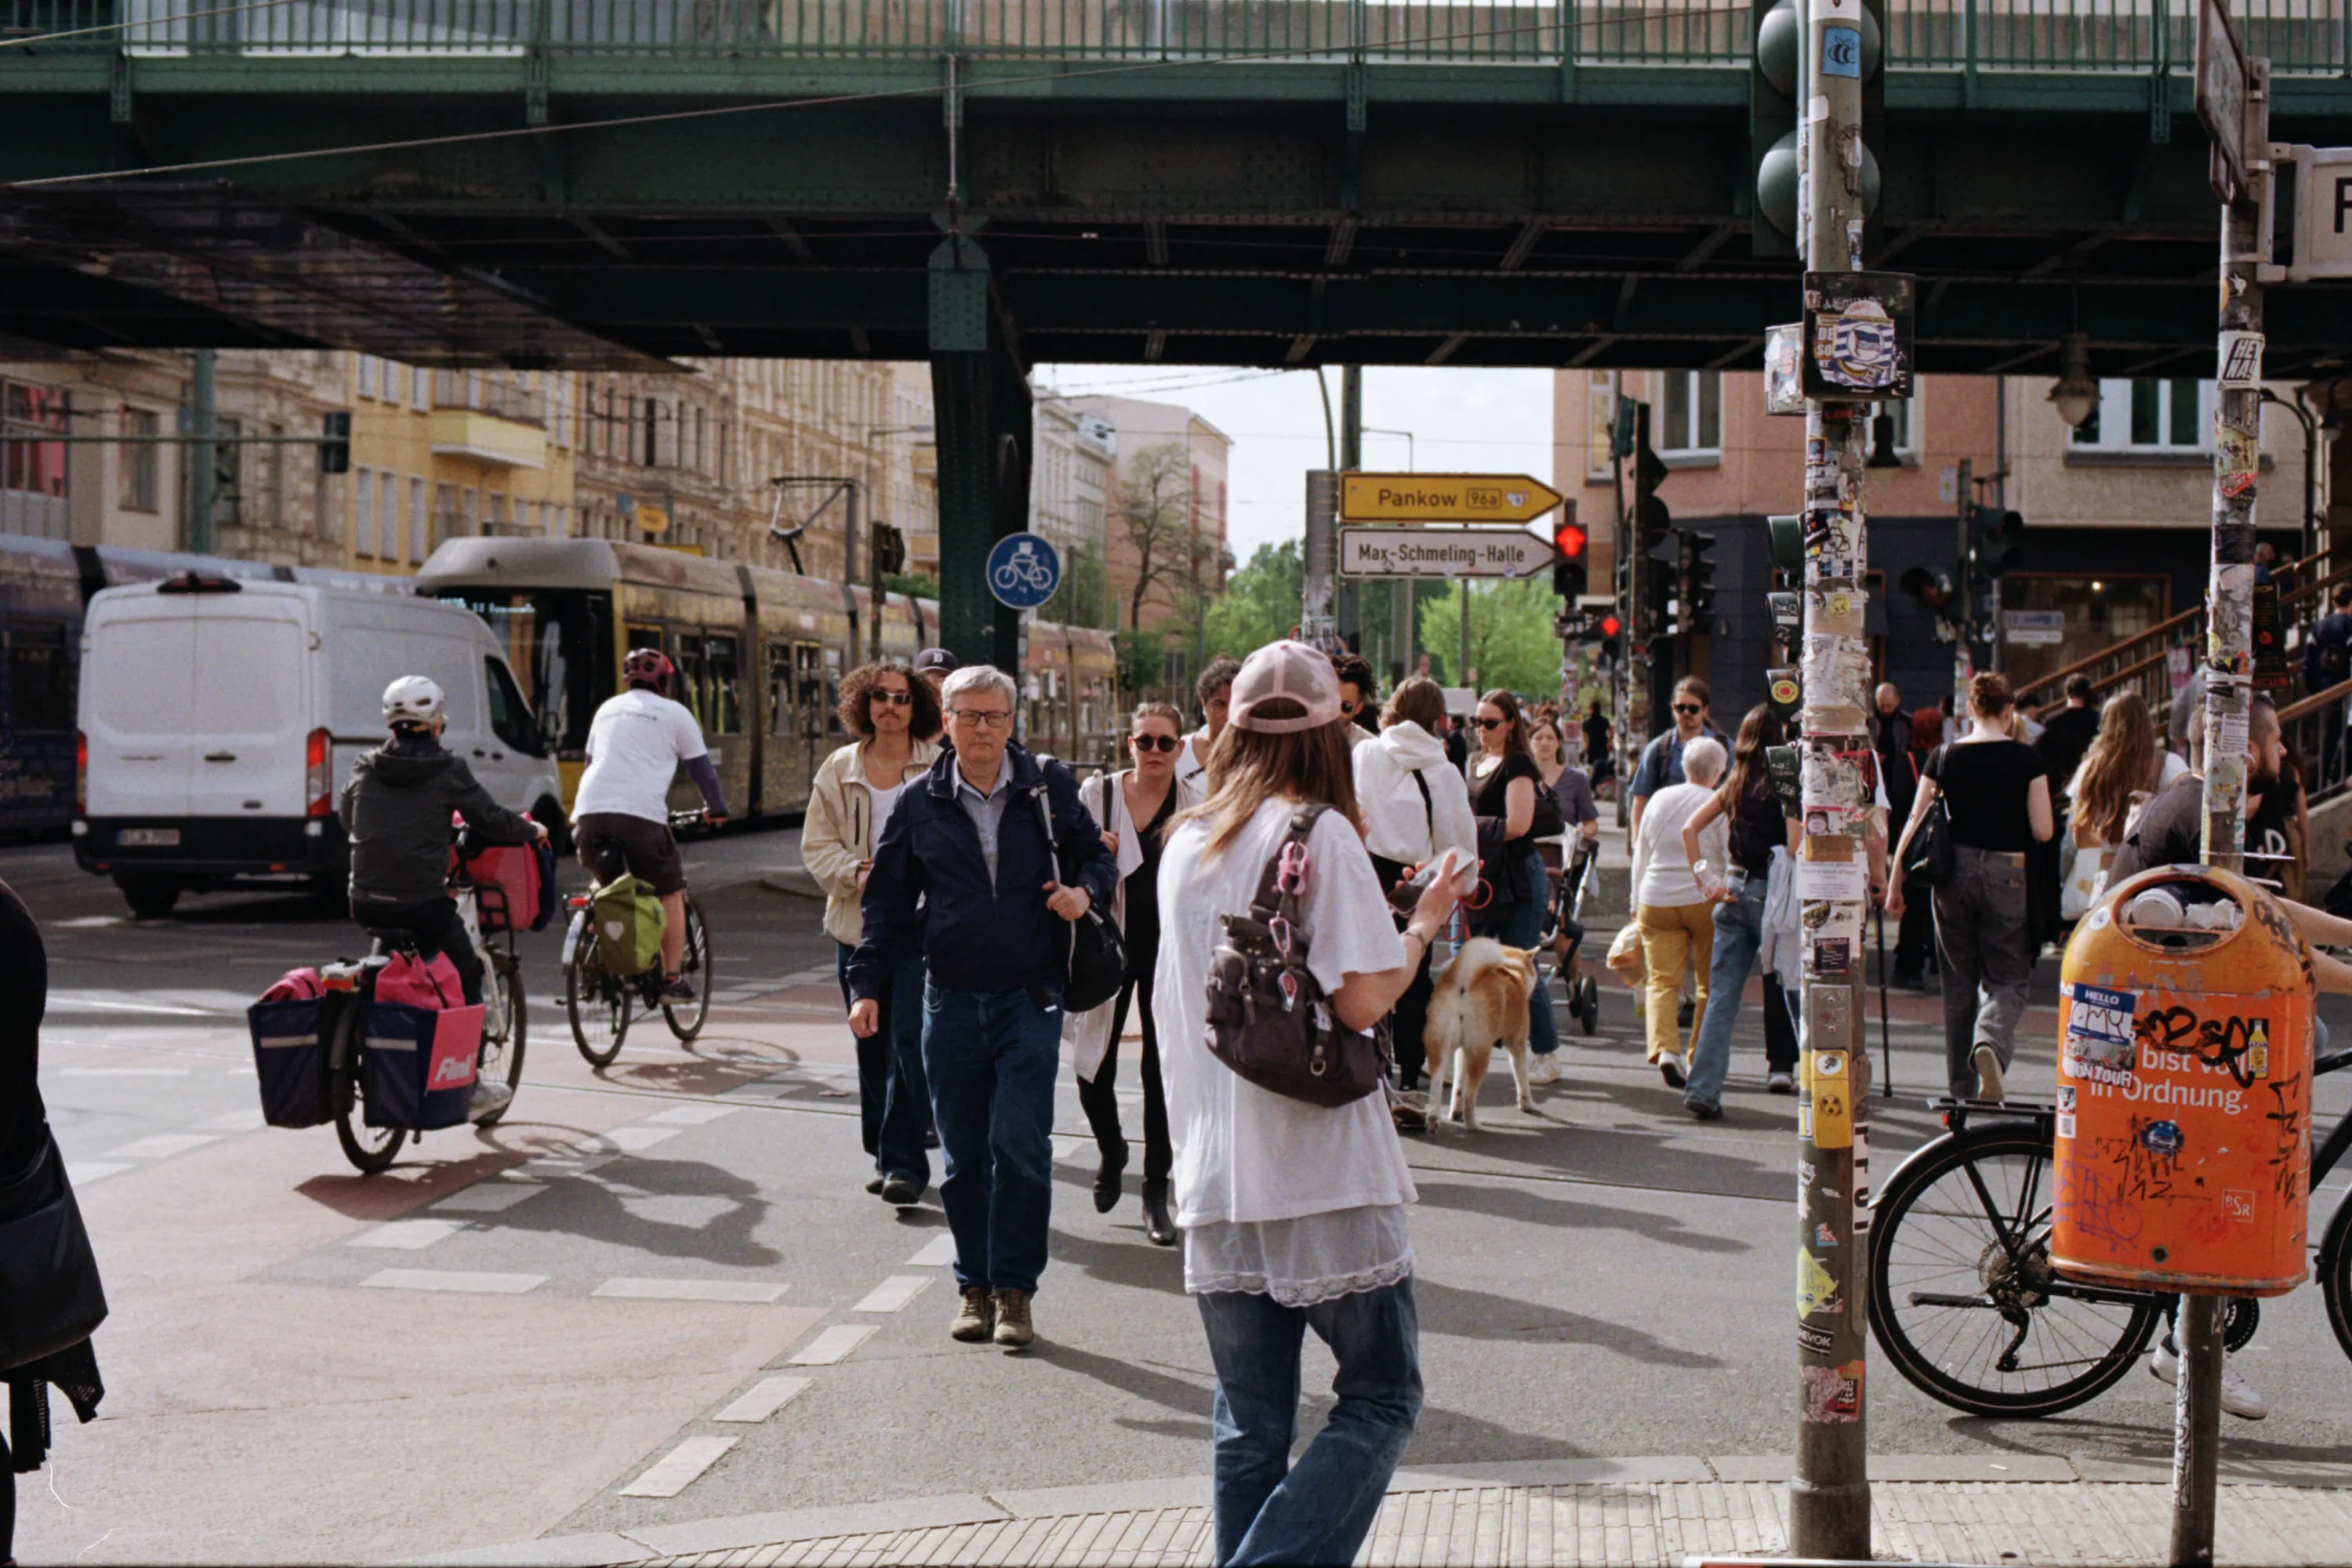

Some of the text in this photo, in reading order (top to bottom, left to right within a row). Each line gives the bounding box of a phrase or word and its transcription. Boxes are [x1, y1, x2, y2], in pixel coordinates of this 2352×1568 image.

[1378, 489, 1497, 506] Pankow 96a
[1358, 544, 1525, 562] Max-Schmeling-Halle
[2085, 989, 2120, 1005] HELLO
[2142, 1044, 2192, 1073] bist
[2122, 1076, 2249, 1115] Ordnung.
[2226, 1195, 2250, 1216] BSR
